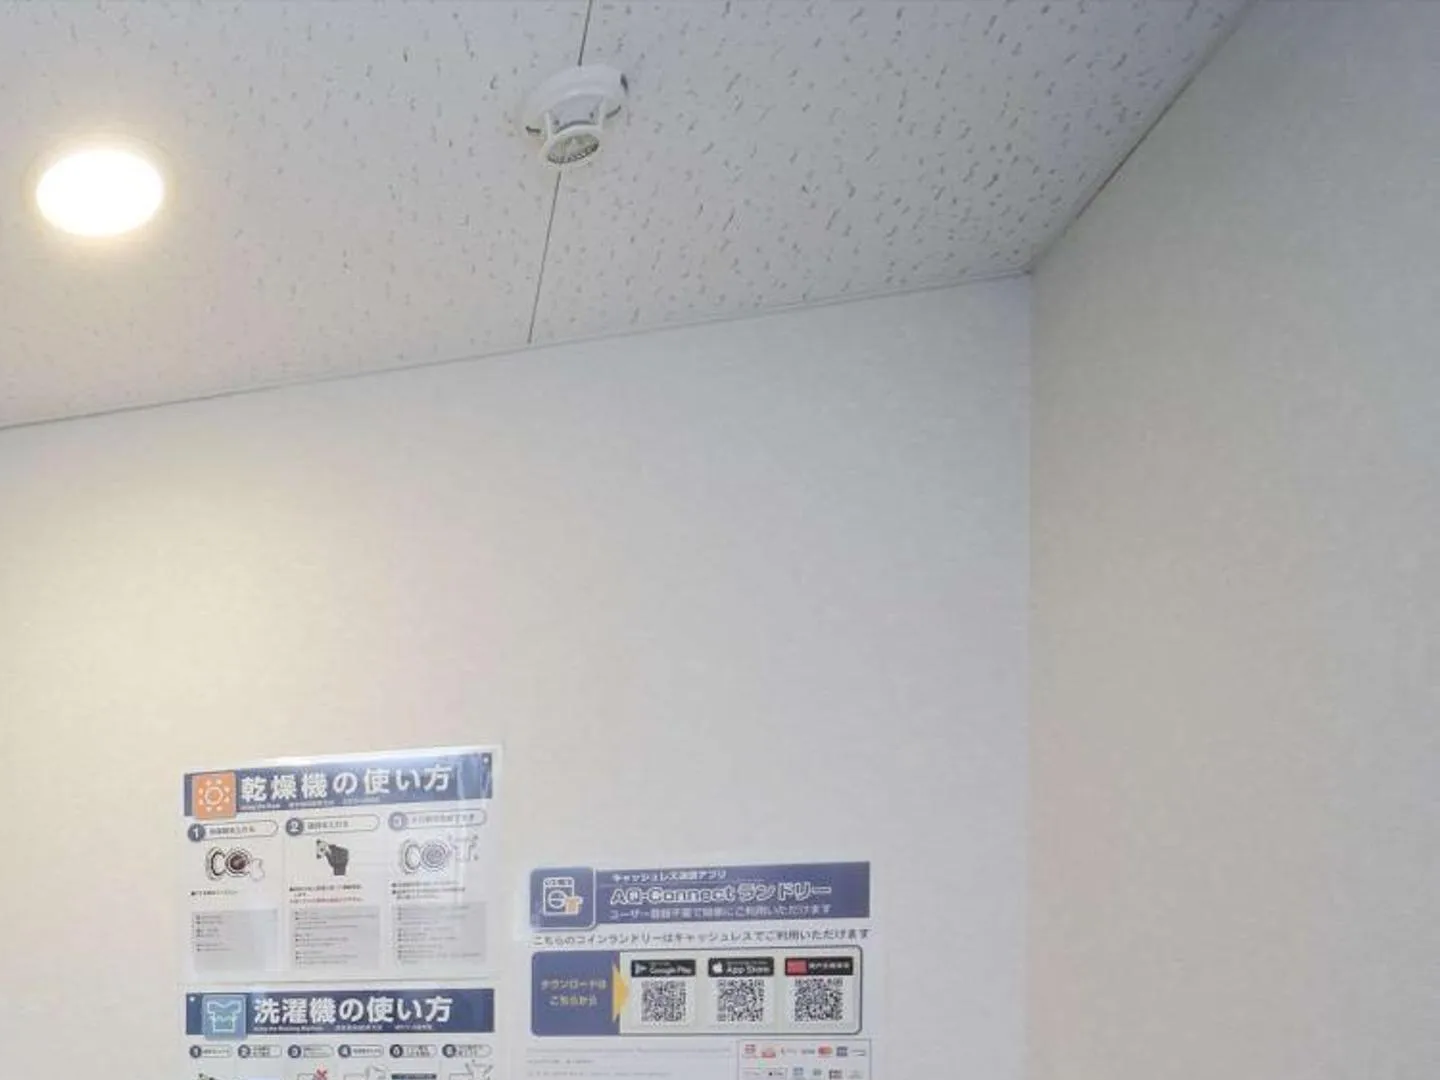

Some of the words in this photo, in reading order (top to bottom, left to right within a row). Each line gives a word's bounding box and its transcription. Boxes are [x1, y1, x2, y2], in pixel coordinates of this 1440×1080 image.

[240, 764, 452, 803] 乾燥機の使い方
[253, 995, 454, 1026] 洗濯機の使い方
